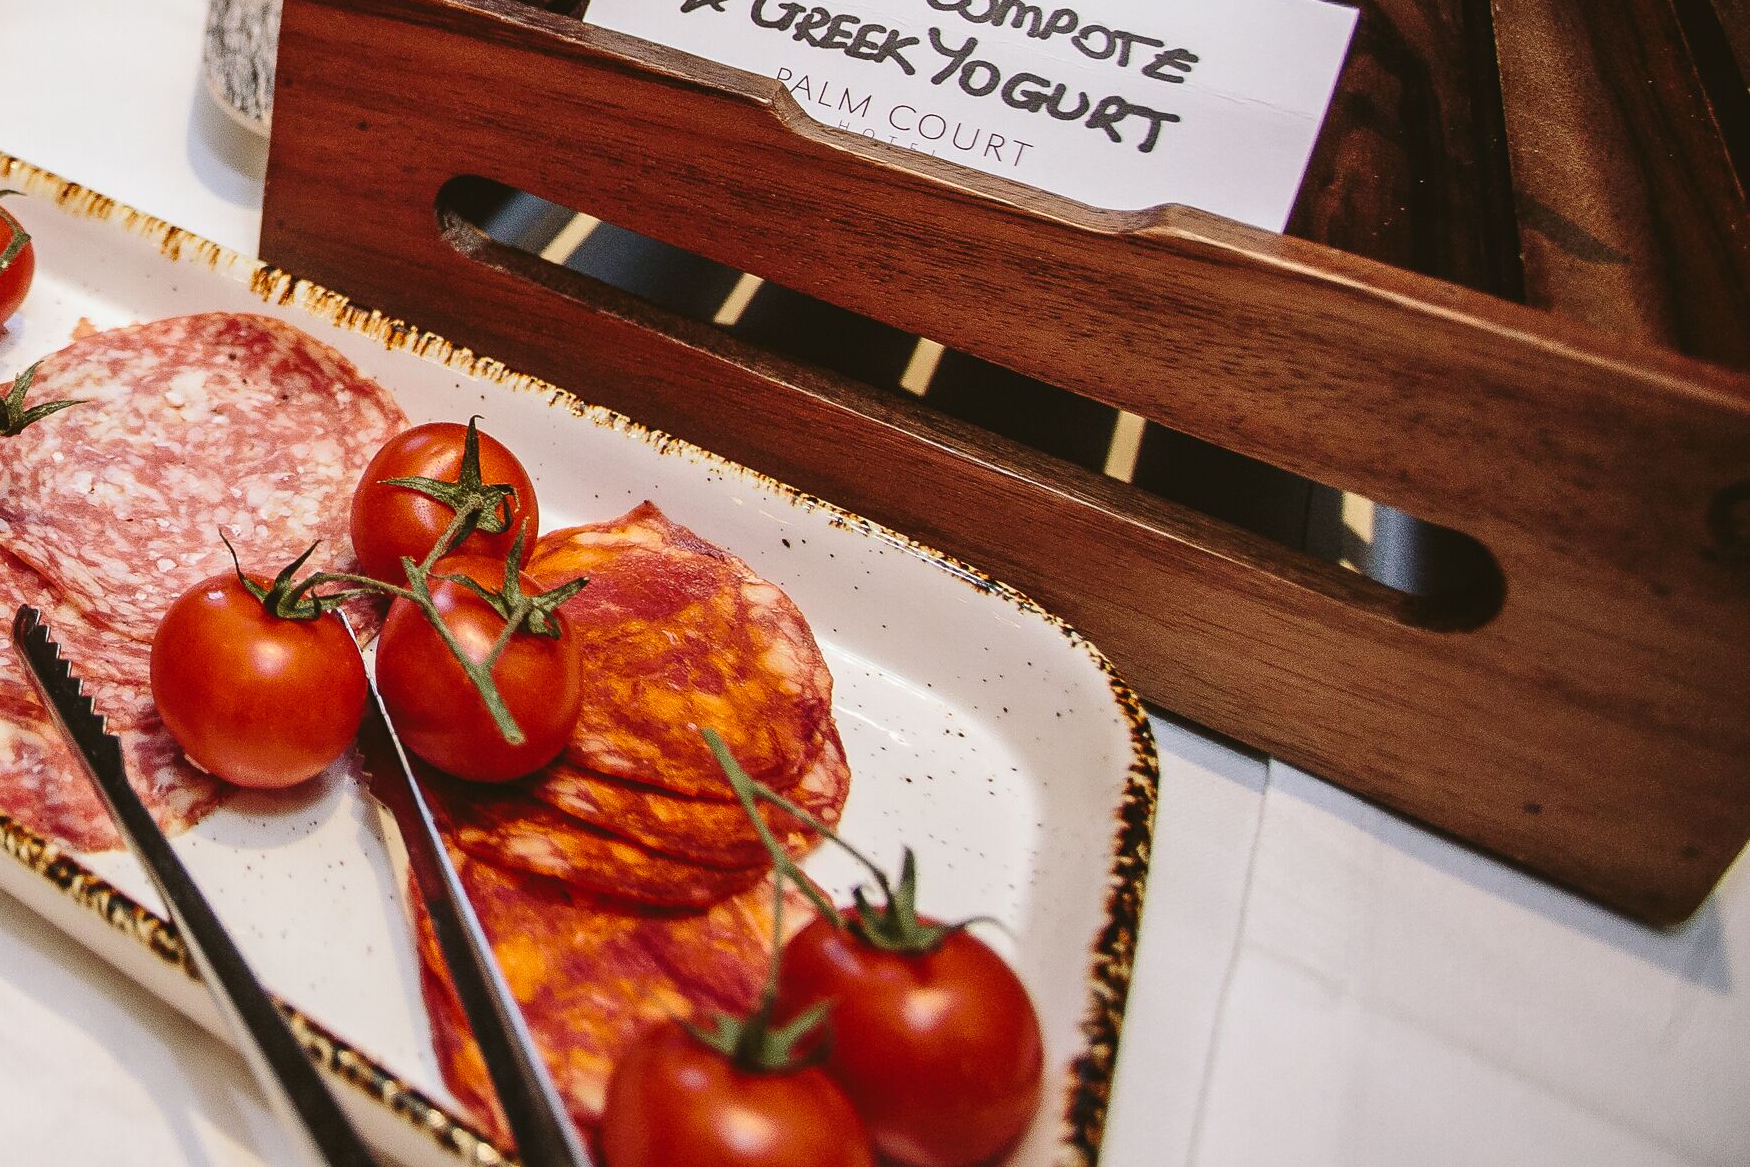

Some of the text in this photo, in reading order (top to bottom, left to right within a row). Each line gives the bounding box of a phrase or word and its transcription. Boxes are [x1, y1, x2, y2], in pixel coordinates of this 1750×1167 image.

[776, 66, 1034, 167] PALM COURT
[928, 26, 1181, 153] YOGURT
